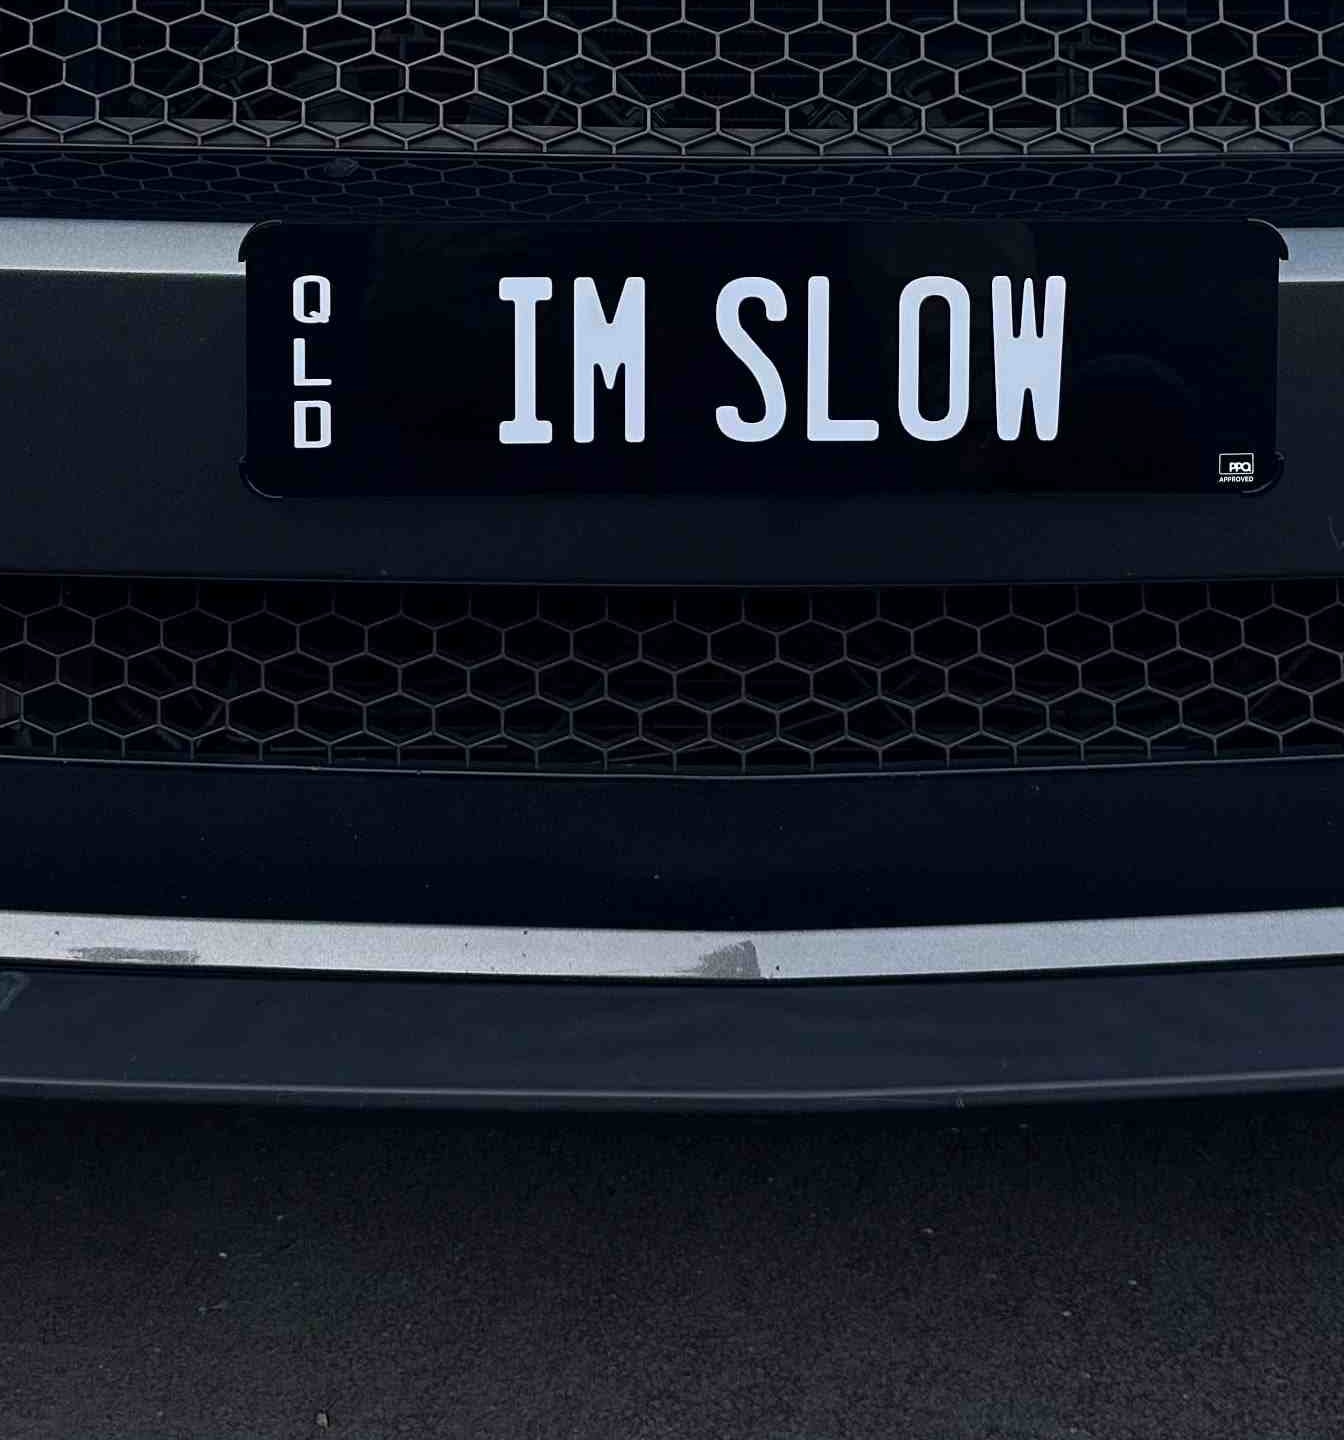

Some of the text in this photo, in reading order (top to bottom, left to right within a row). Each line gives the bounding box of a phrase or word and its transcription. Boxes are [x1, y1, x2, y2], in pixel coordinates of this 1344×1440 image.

[292, 274, 332, 449] QLD
[498, 275, 1067, 445] IM SLOW
[1218, 475, 1254, 483] APPROVED
